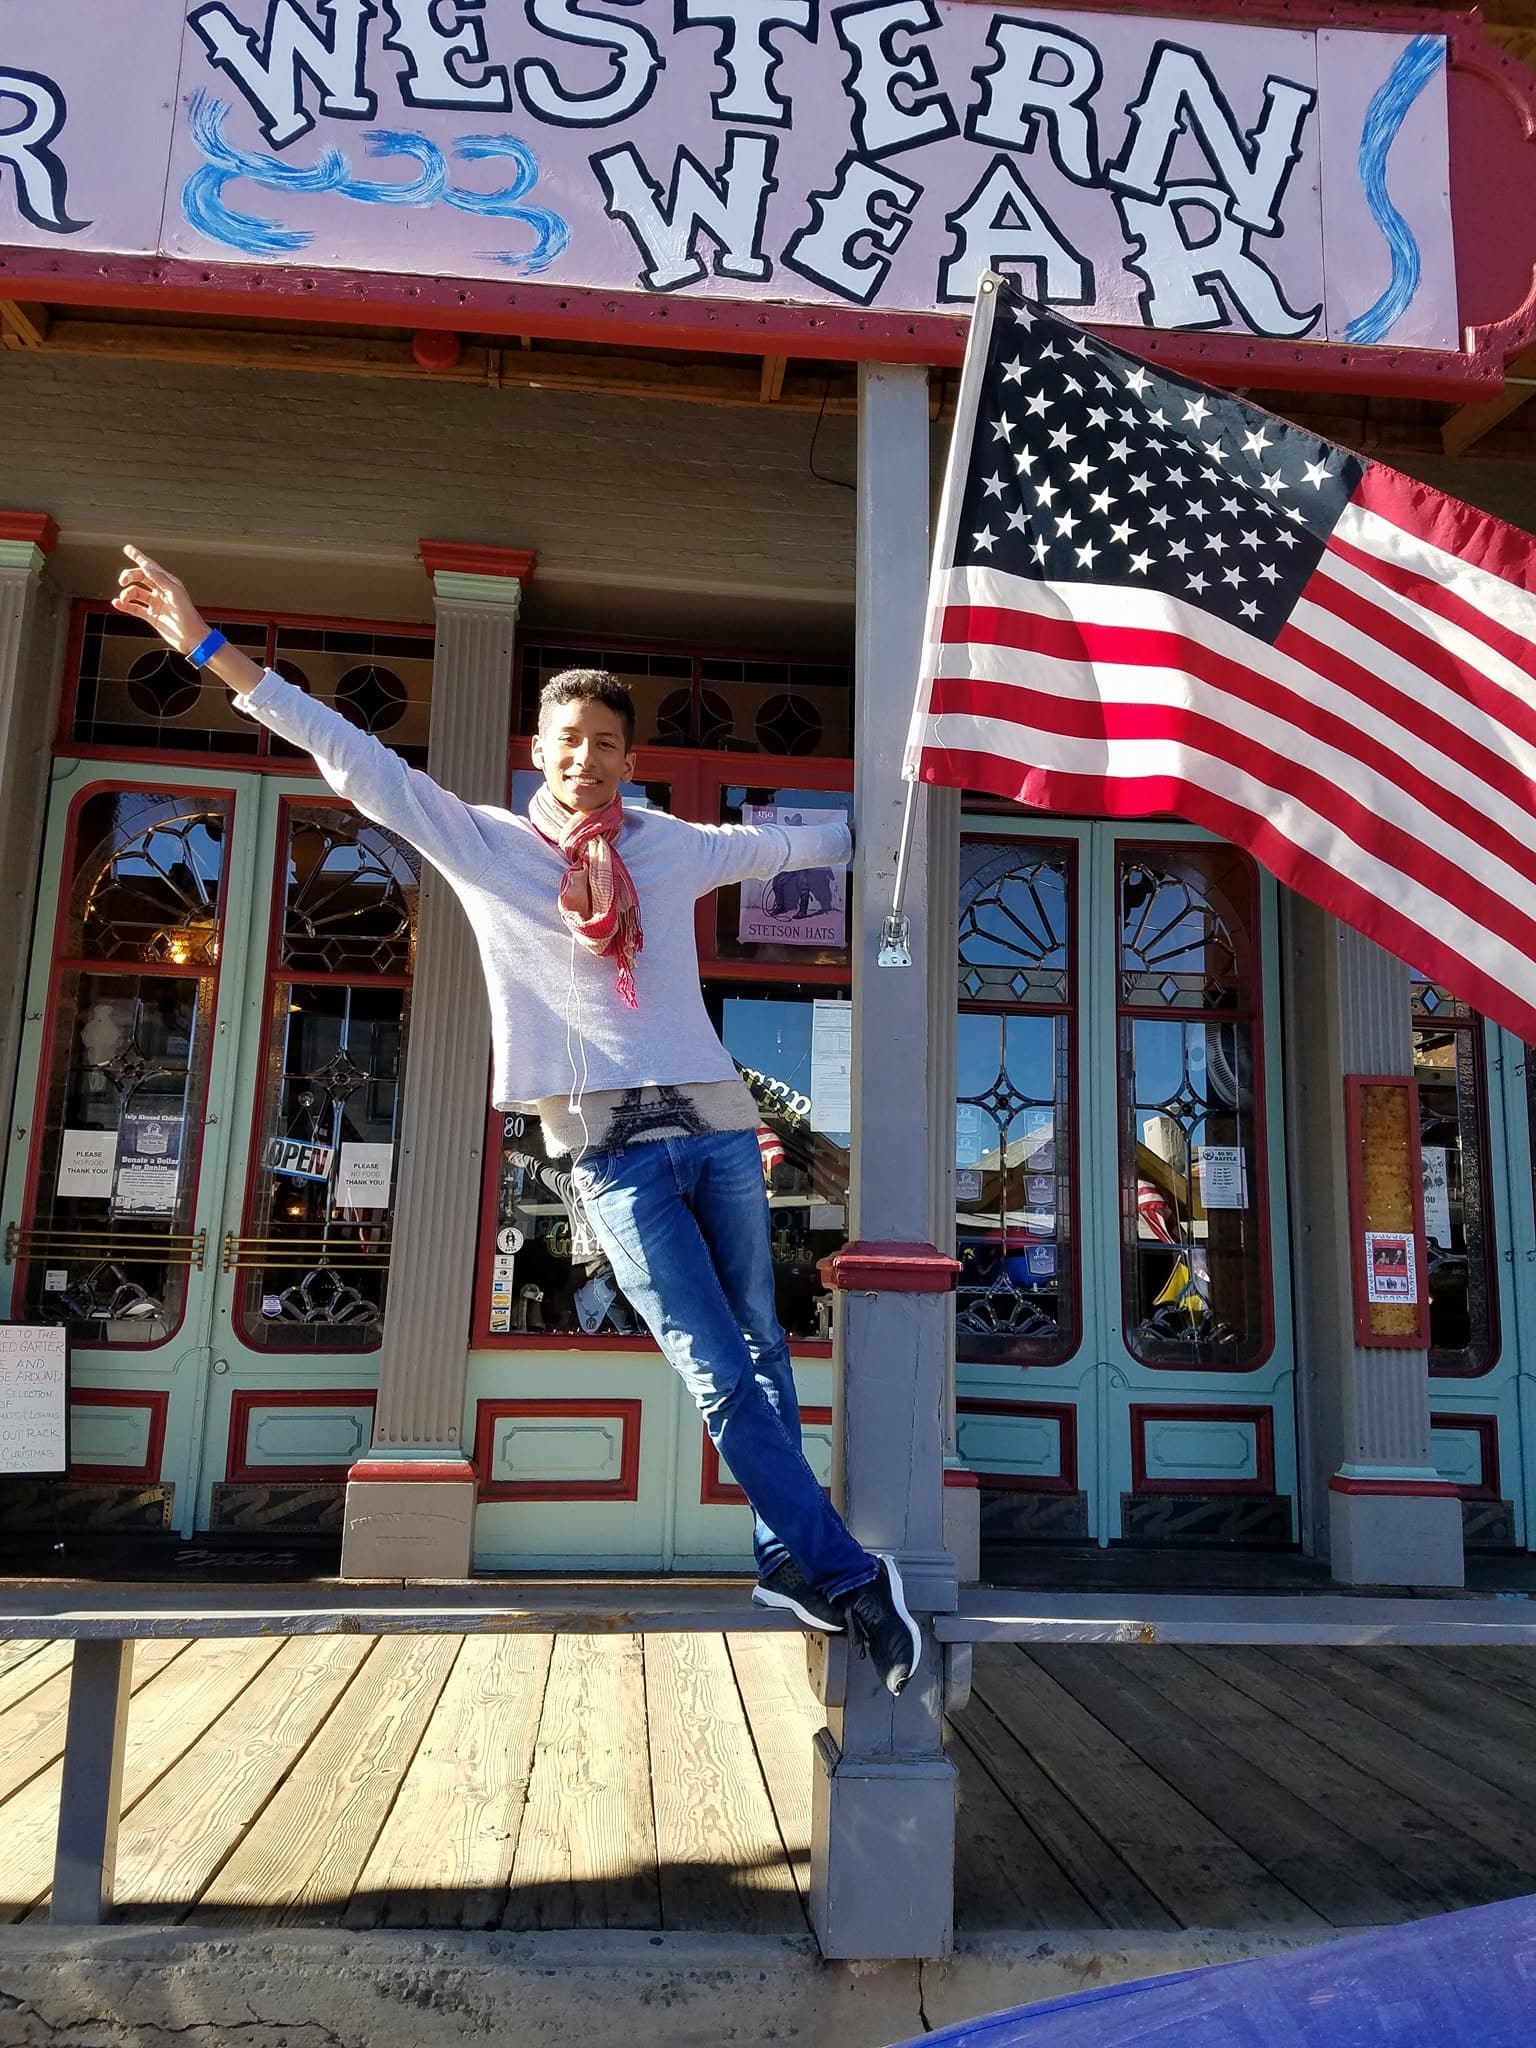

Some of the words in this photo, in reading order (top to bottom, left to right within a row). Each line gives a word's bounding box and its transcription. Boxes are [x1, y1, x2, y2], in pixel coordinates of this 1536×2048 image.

[187, 0, 1317, 238] WESTERN
[589, 130, 1322, 339] WEAR
[749, 924, 800, 938] STETSON
[805, 927, 835, 939] HATS
[504, 1117, 525, 1138] 80
[76, 1151, 103, 1159] PLEASE
[121, 1156, 149, 1164] Donate
[267, 1139, 330, 1177] OPEN
[67, 1167, 91, 1175] THANK
[131, 1163, 143, 1171] for
[17, 1329, 33, 1340] TO
[38, 1329, 59, 1340] THE
[20, 1340, 65, 1354] GARTER
[16, 1358, 45, 1370] AND
[16, 1370, 64, 1384] AROUND
[26, 1427, 61, 1439] RACK
